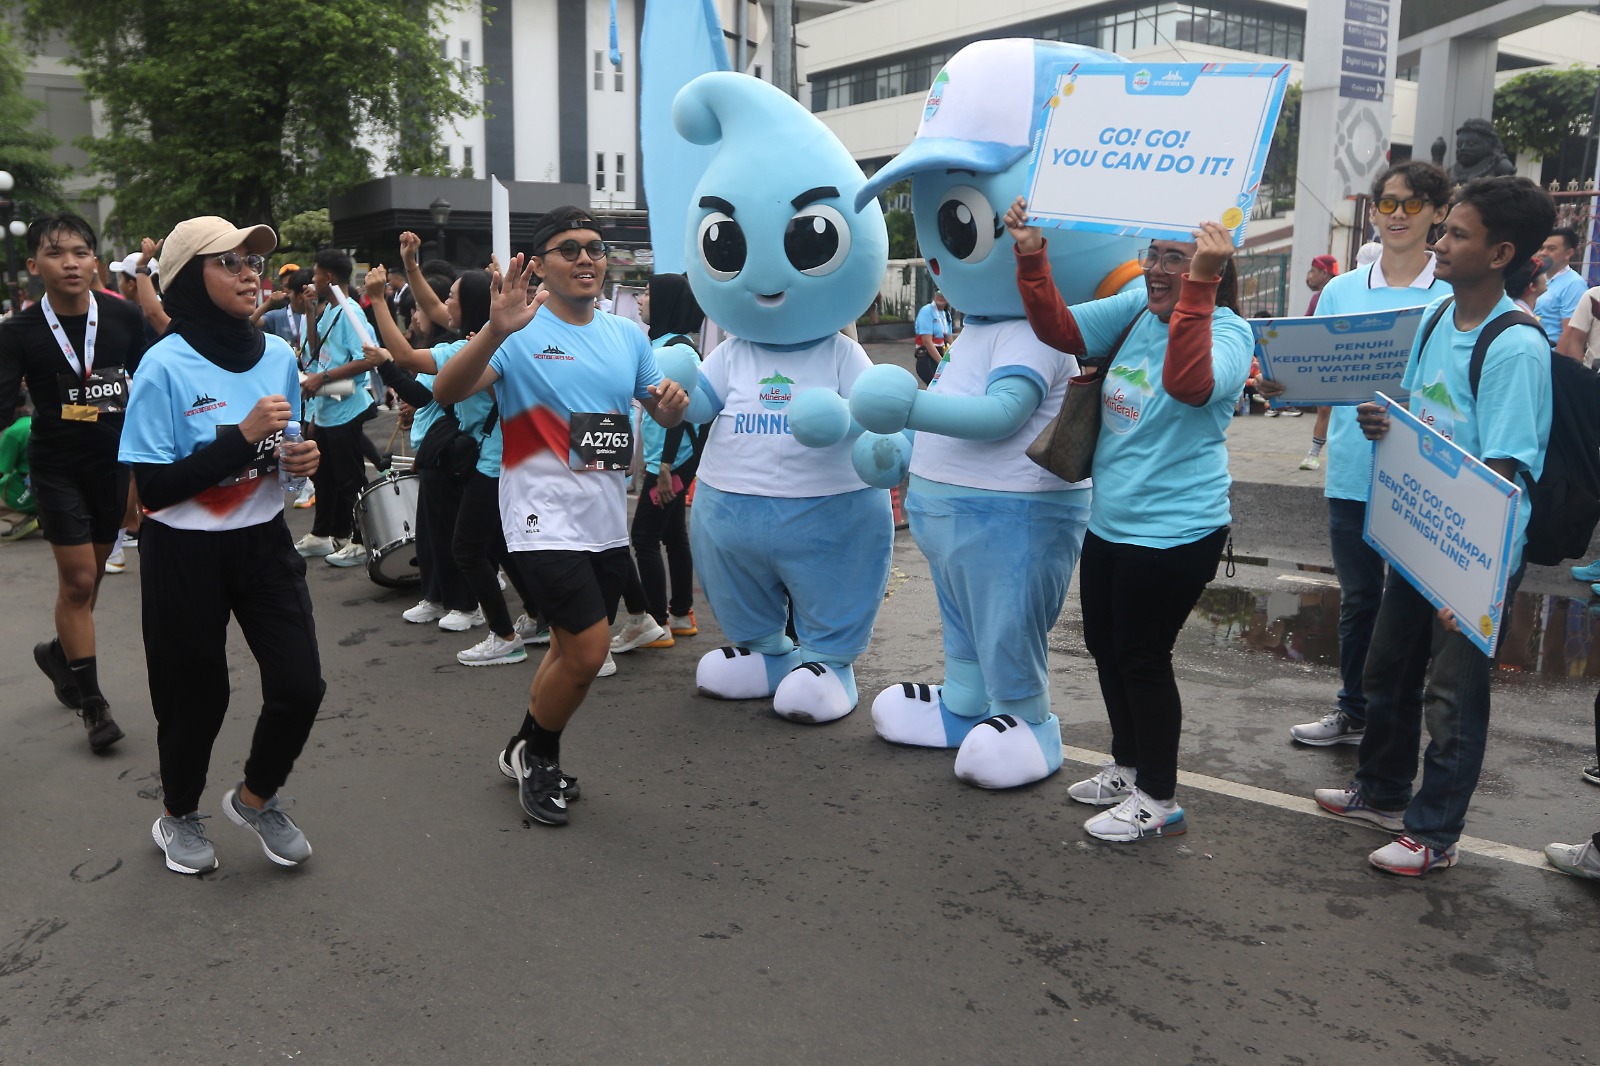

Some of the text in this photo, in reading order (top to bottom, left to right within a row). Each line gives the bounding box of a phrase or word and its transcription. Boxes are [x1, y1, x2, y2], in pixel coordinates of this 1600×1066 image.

[1099, 127, 1190, 149] GO! GO!
[1052, 148, 1234, 176] YOU CAN DO IT!
[1335, 340, 1394, 351] PENUHI
[1273, 349, 1409, 363] KEBUTUHAN MINE
[1317, 364, 1371, 373] WATER
[1321, 372, 1403, 383] LE MINERA
[770, 386, 780, 395] Le
[1113, 387, 1125, 403] Le
[1420, 408, 1435, 426] Le
[580, 431, 629, 448] A2763
[1402, 473, 1466, 530] GO! GO! GO!
[1378, 470, 1492, 570] BENTAR LAGI SAMPAI
[1391, 498, 1470, 571] DI FINISH LINE!
